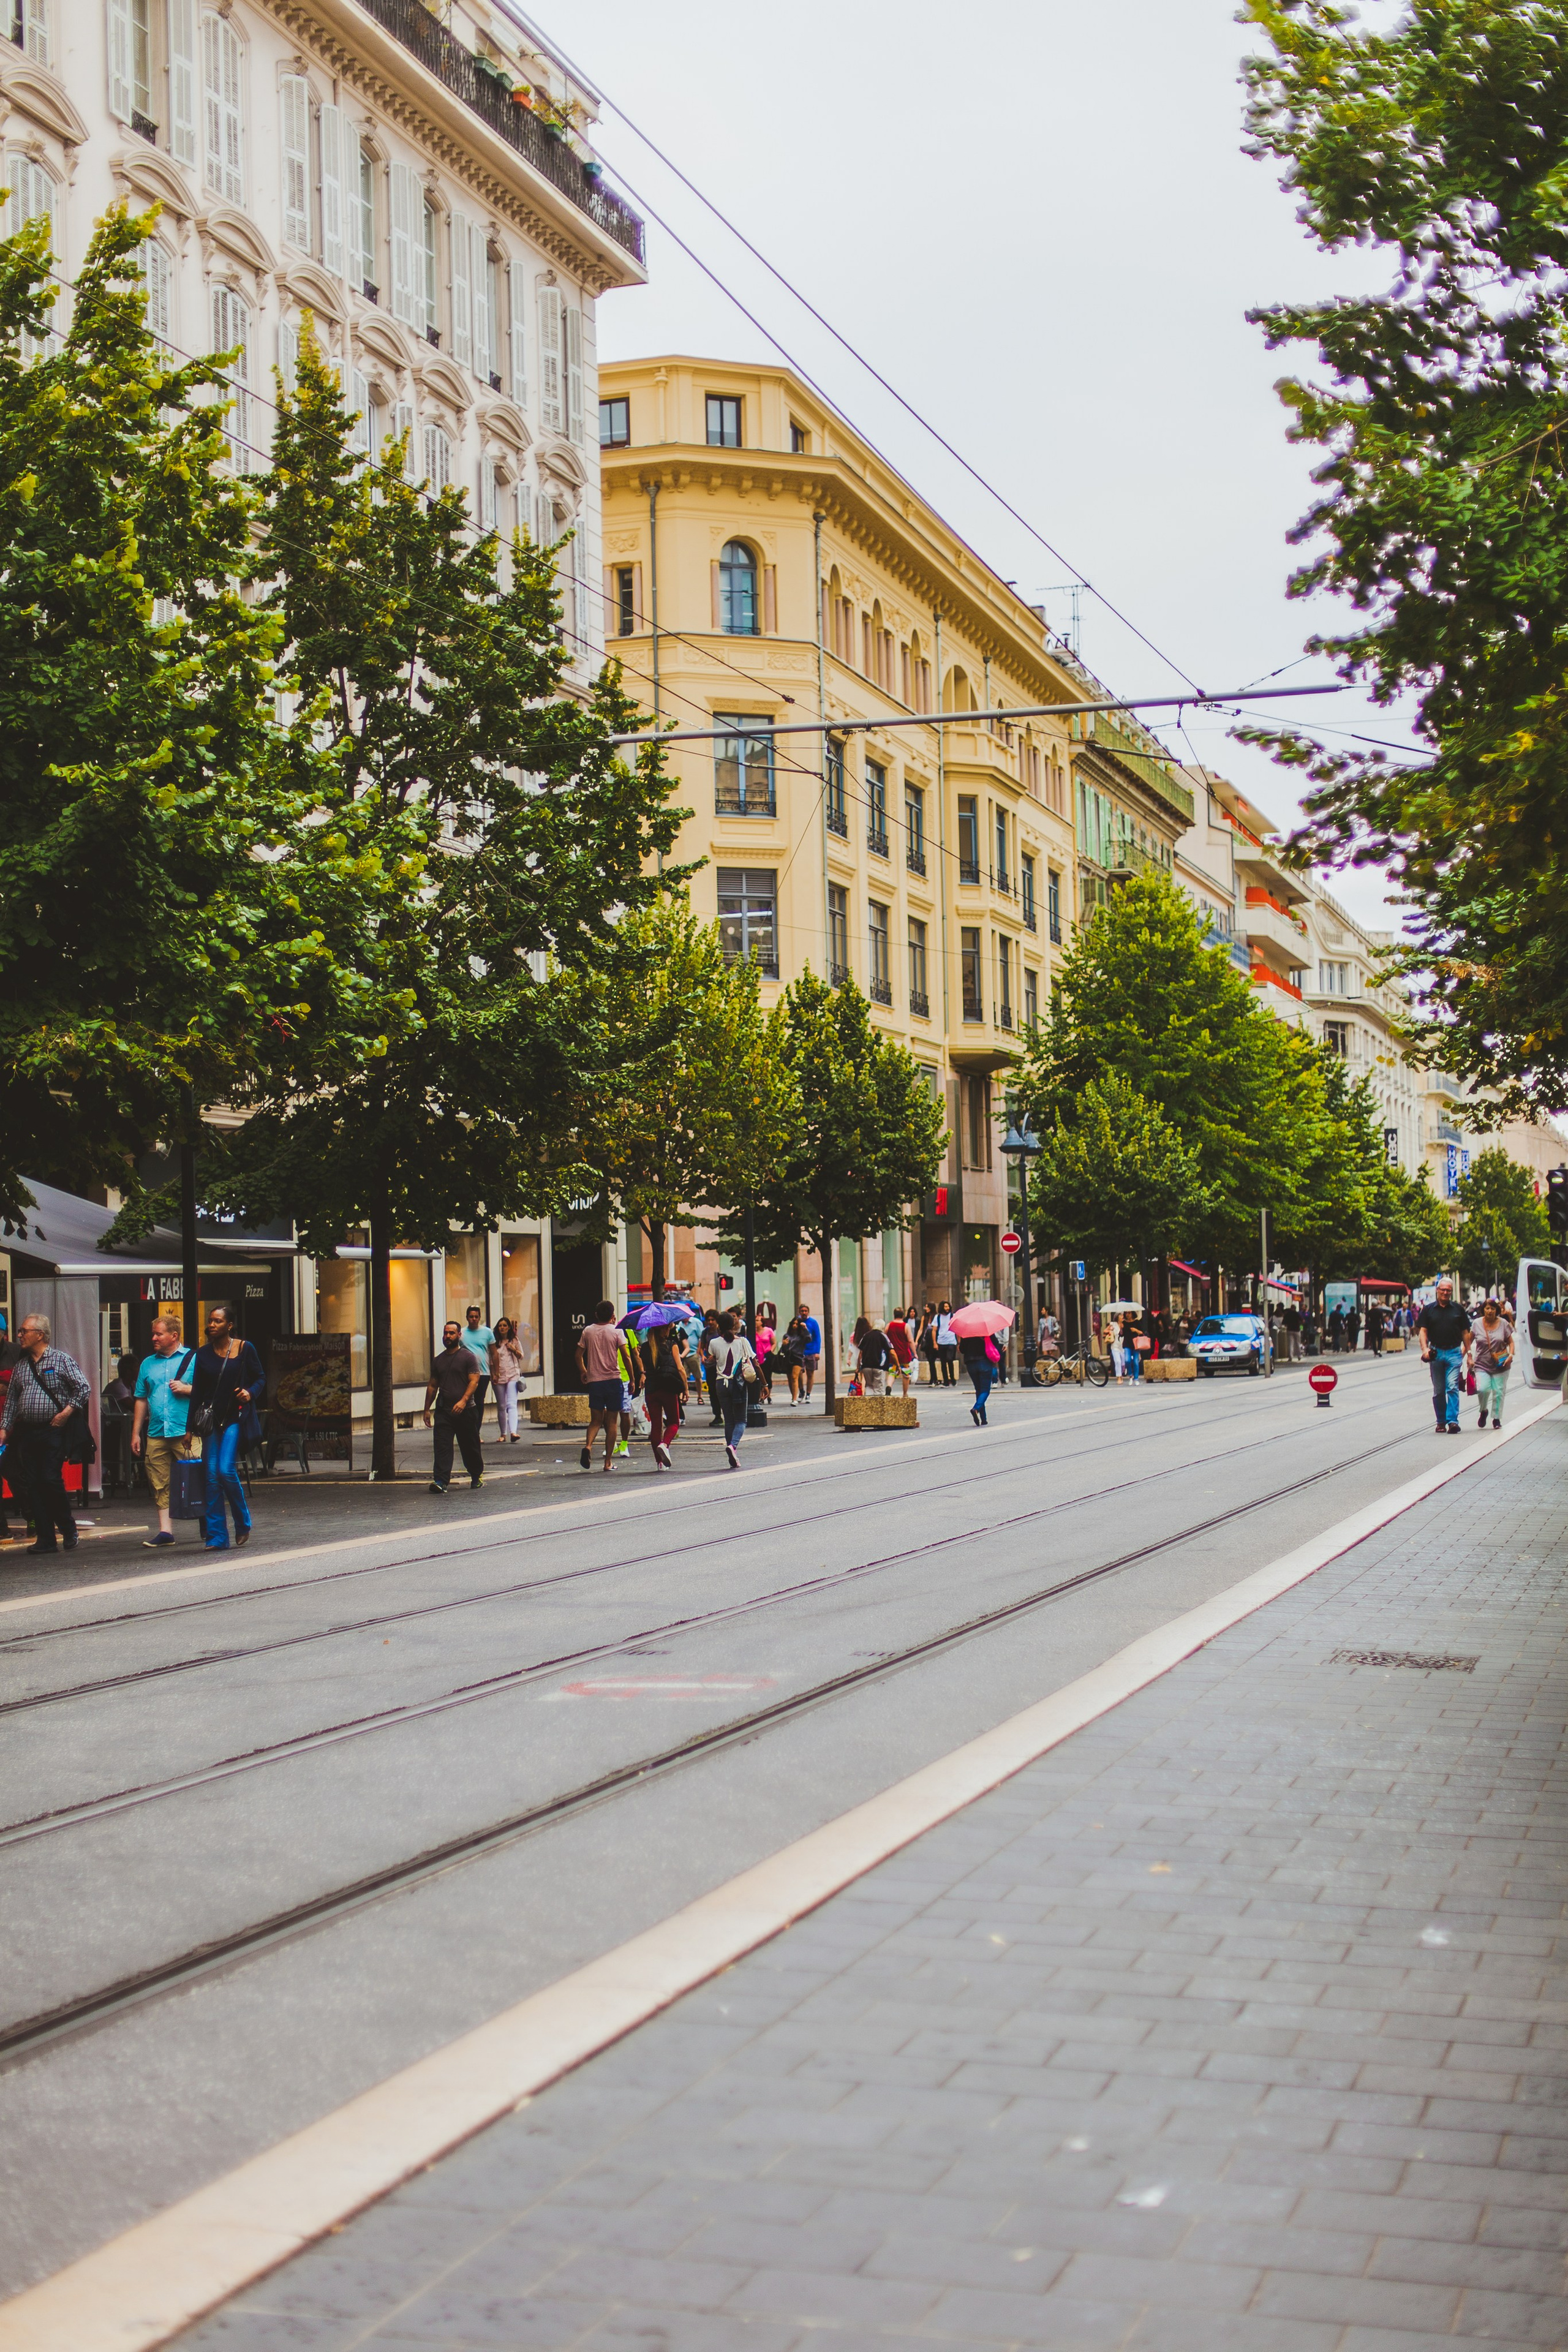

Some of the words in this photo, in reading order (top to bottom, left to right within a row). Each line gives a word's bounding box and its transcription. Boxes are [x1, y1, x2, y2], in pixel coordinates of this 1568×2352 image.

[140, 1278, 156, 1300] LA
[246, 1284, 264, 1297] Pizza
[272, 1339, 287, 1351] Pizza
[289, 1343, 322, 1351] Fabrication
[324, 1341, 345, 1351] Maison
